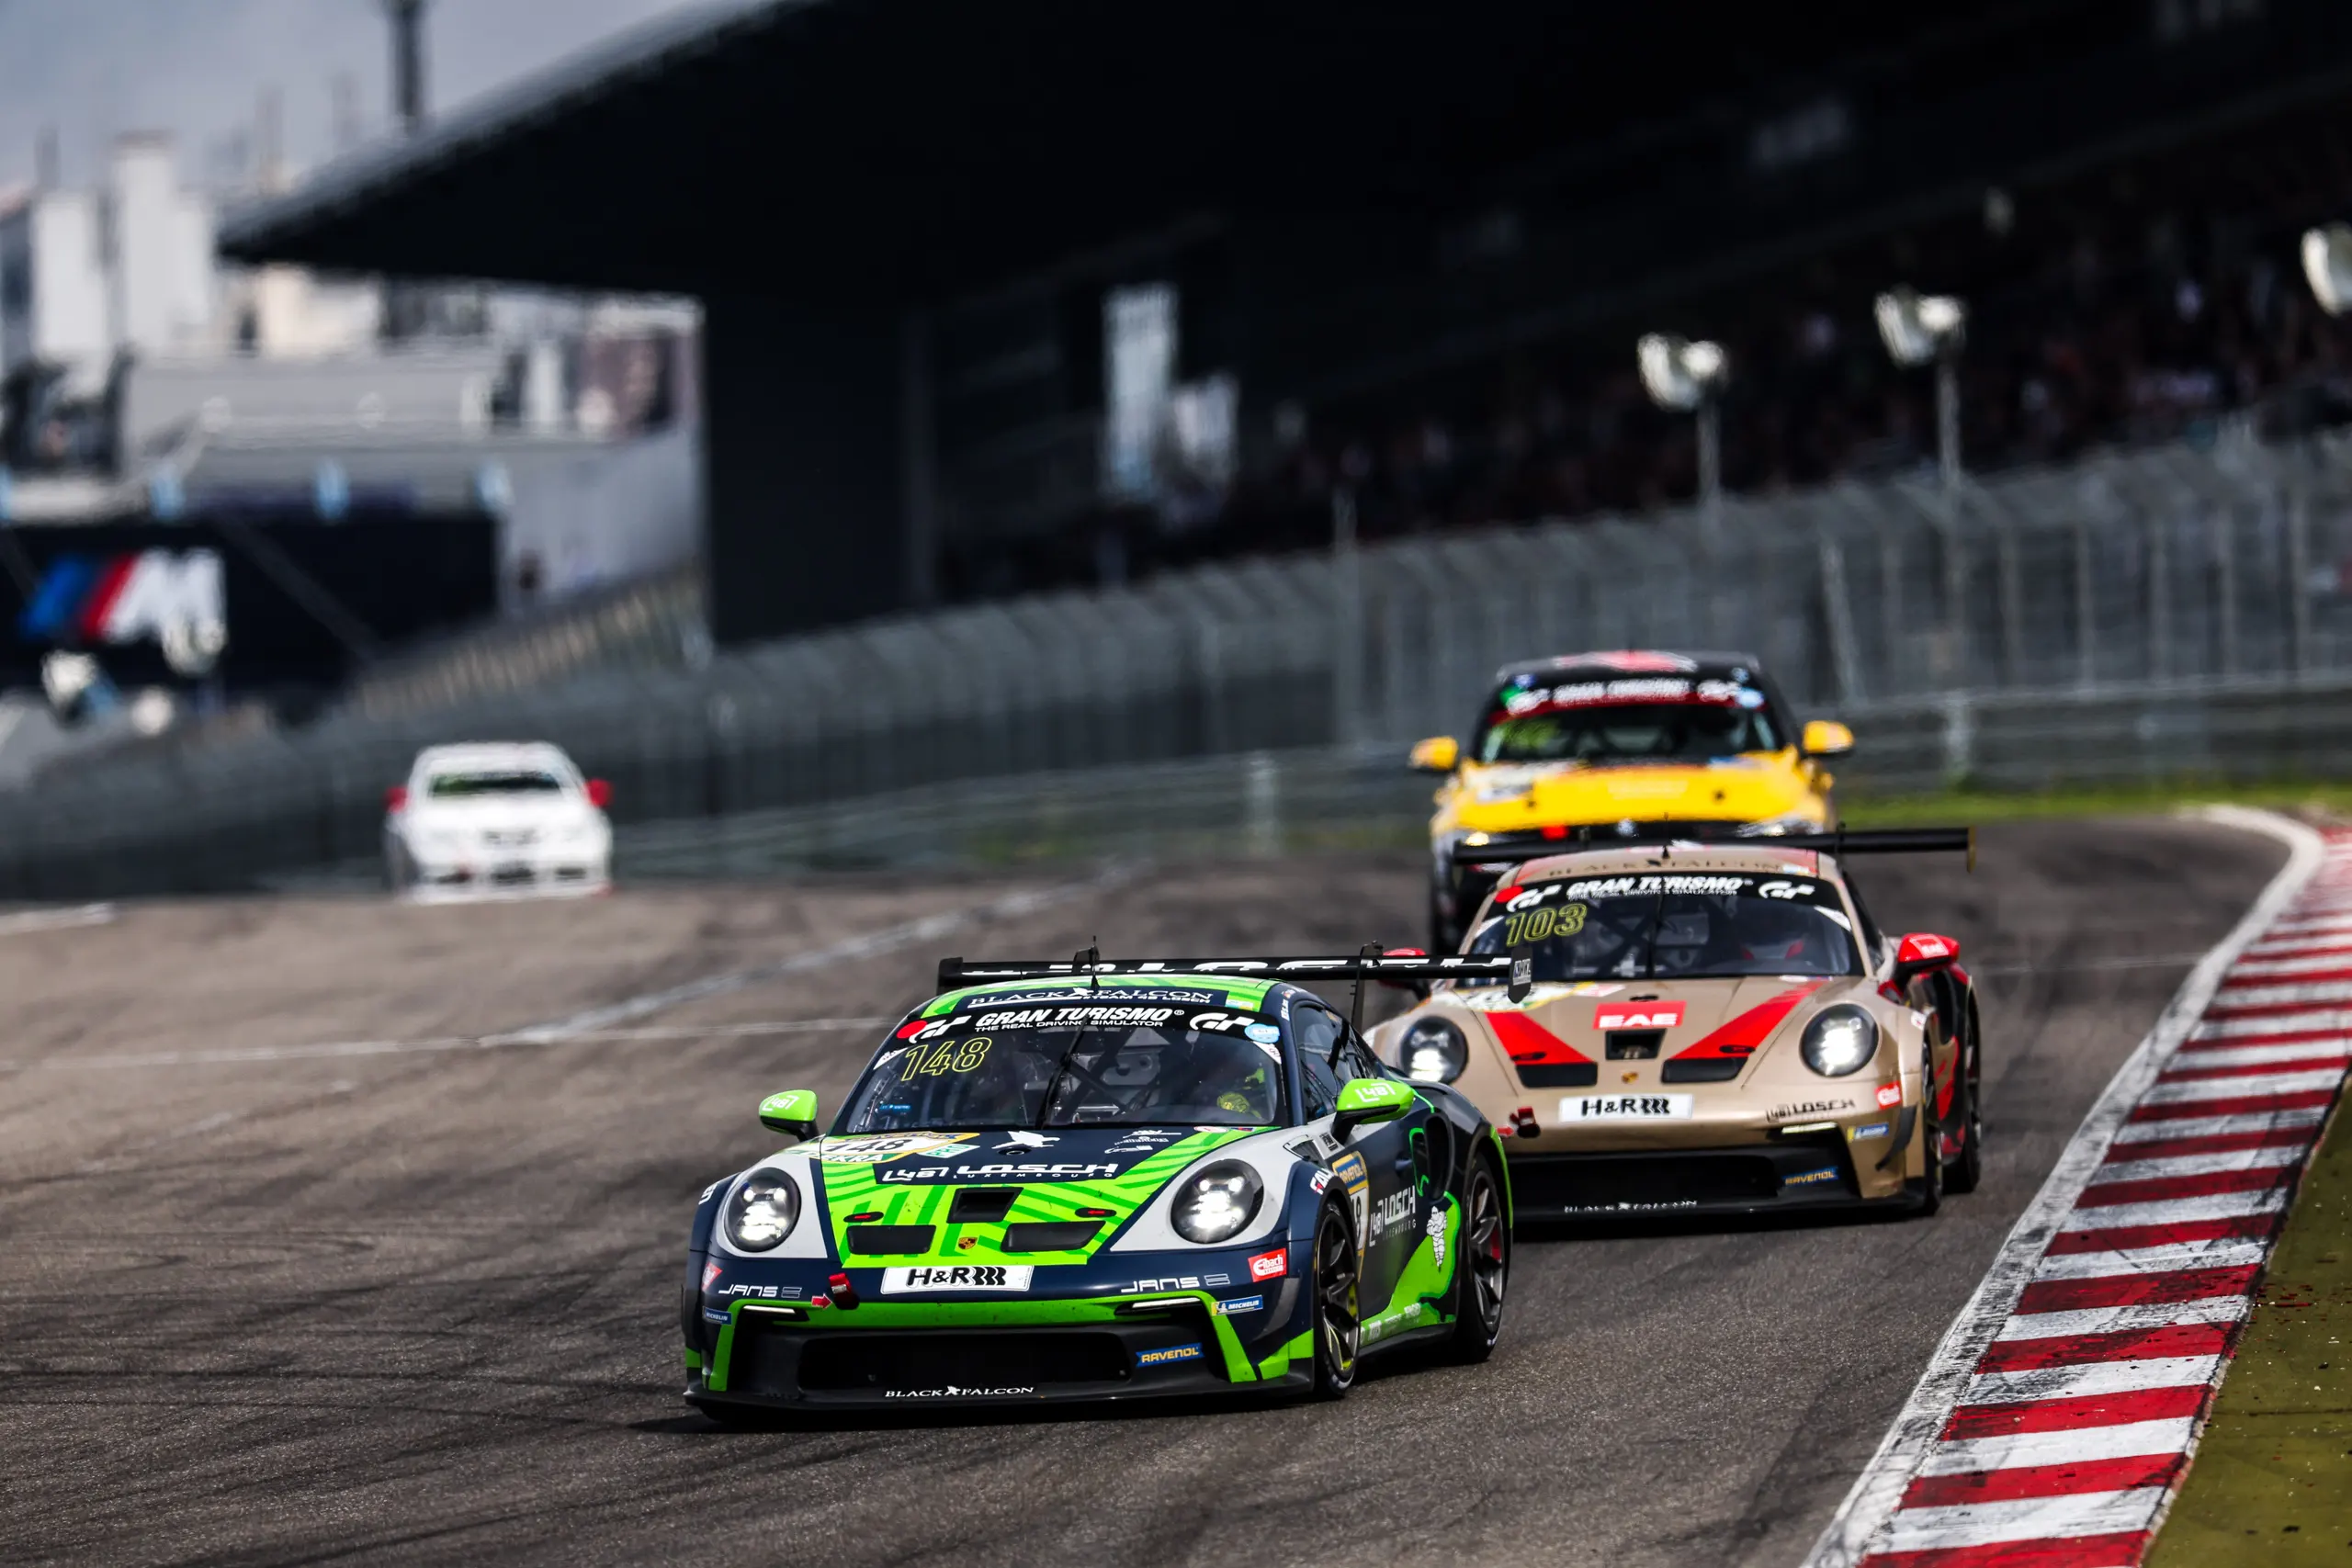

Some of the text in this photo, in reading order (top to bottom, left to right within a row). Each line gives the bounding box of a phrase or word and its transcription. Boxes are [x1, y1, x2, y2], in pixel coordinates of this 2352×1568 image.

[1505, 903, 1588, 947] 103
[971, 989, 1214, 1005] BLACK FALCON
[975, 1007, 1173, 1027] GRAN TURISMO
[1599, 1012, 1678, 1028] EAE
[974, 1024, 1000, 1032] THE
[1001, 1021, 1034, 1030] REAL
[901, 1037, 992, 1081] 148
[825, 1139, 913, 1152] 148
[956, 1163, 1118, 1174] LOSCH
[1785, 1171, 1835, 1185] RAVENOL
[1385, 1185, 1416, 1225] LOSCH
[718, 1284, 778, 1297] JANS
[1121, 1276, 1201, 1293] JANS
[1141, 1347, 1199, 1363] RAVENOL
[885, 1387, 1035, 1397] BLACK FALCON
